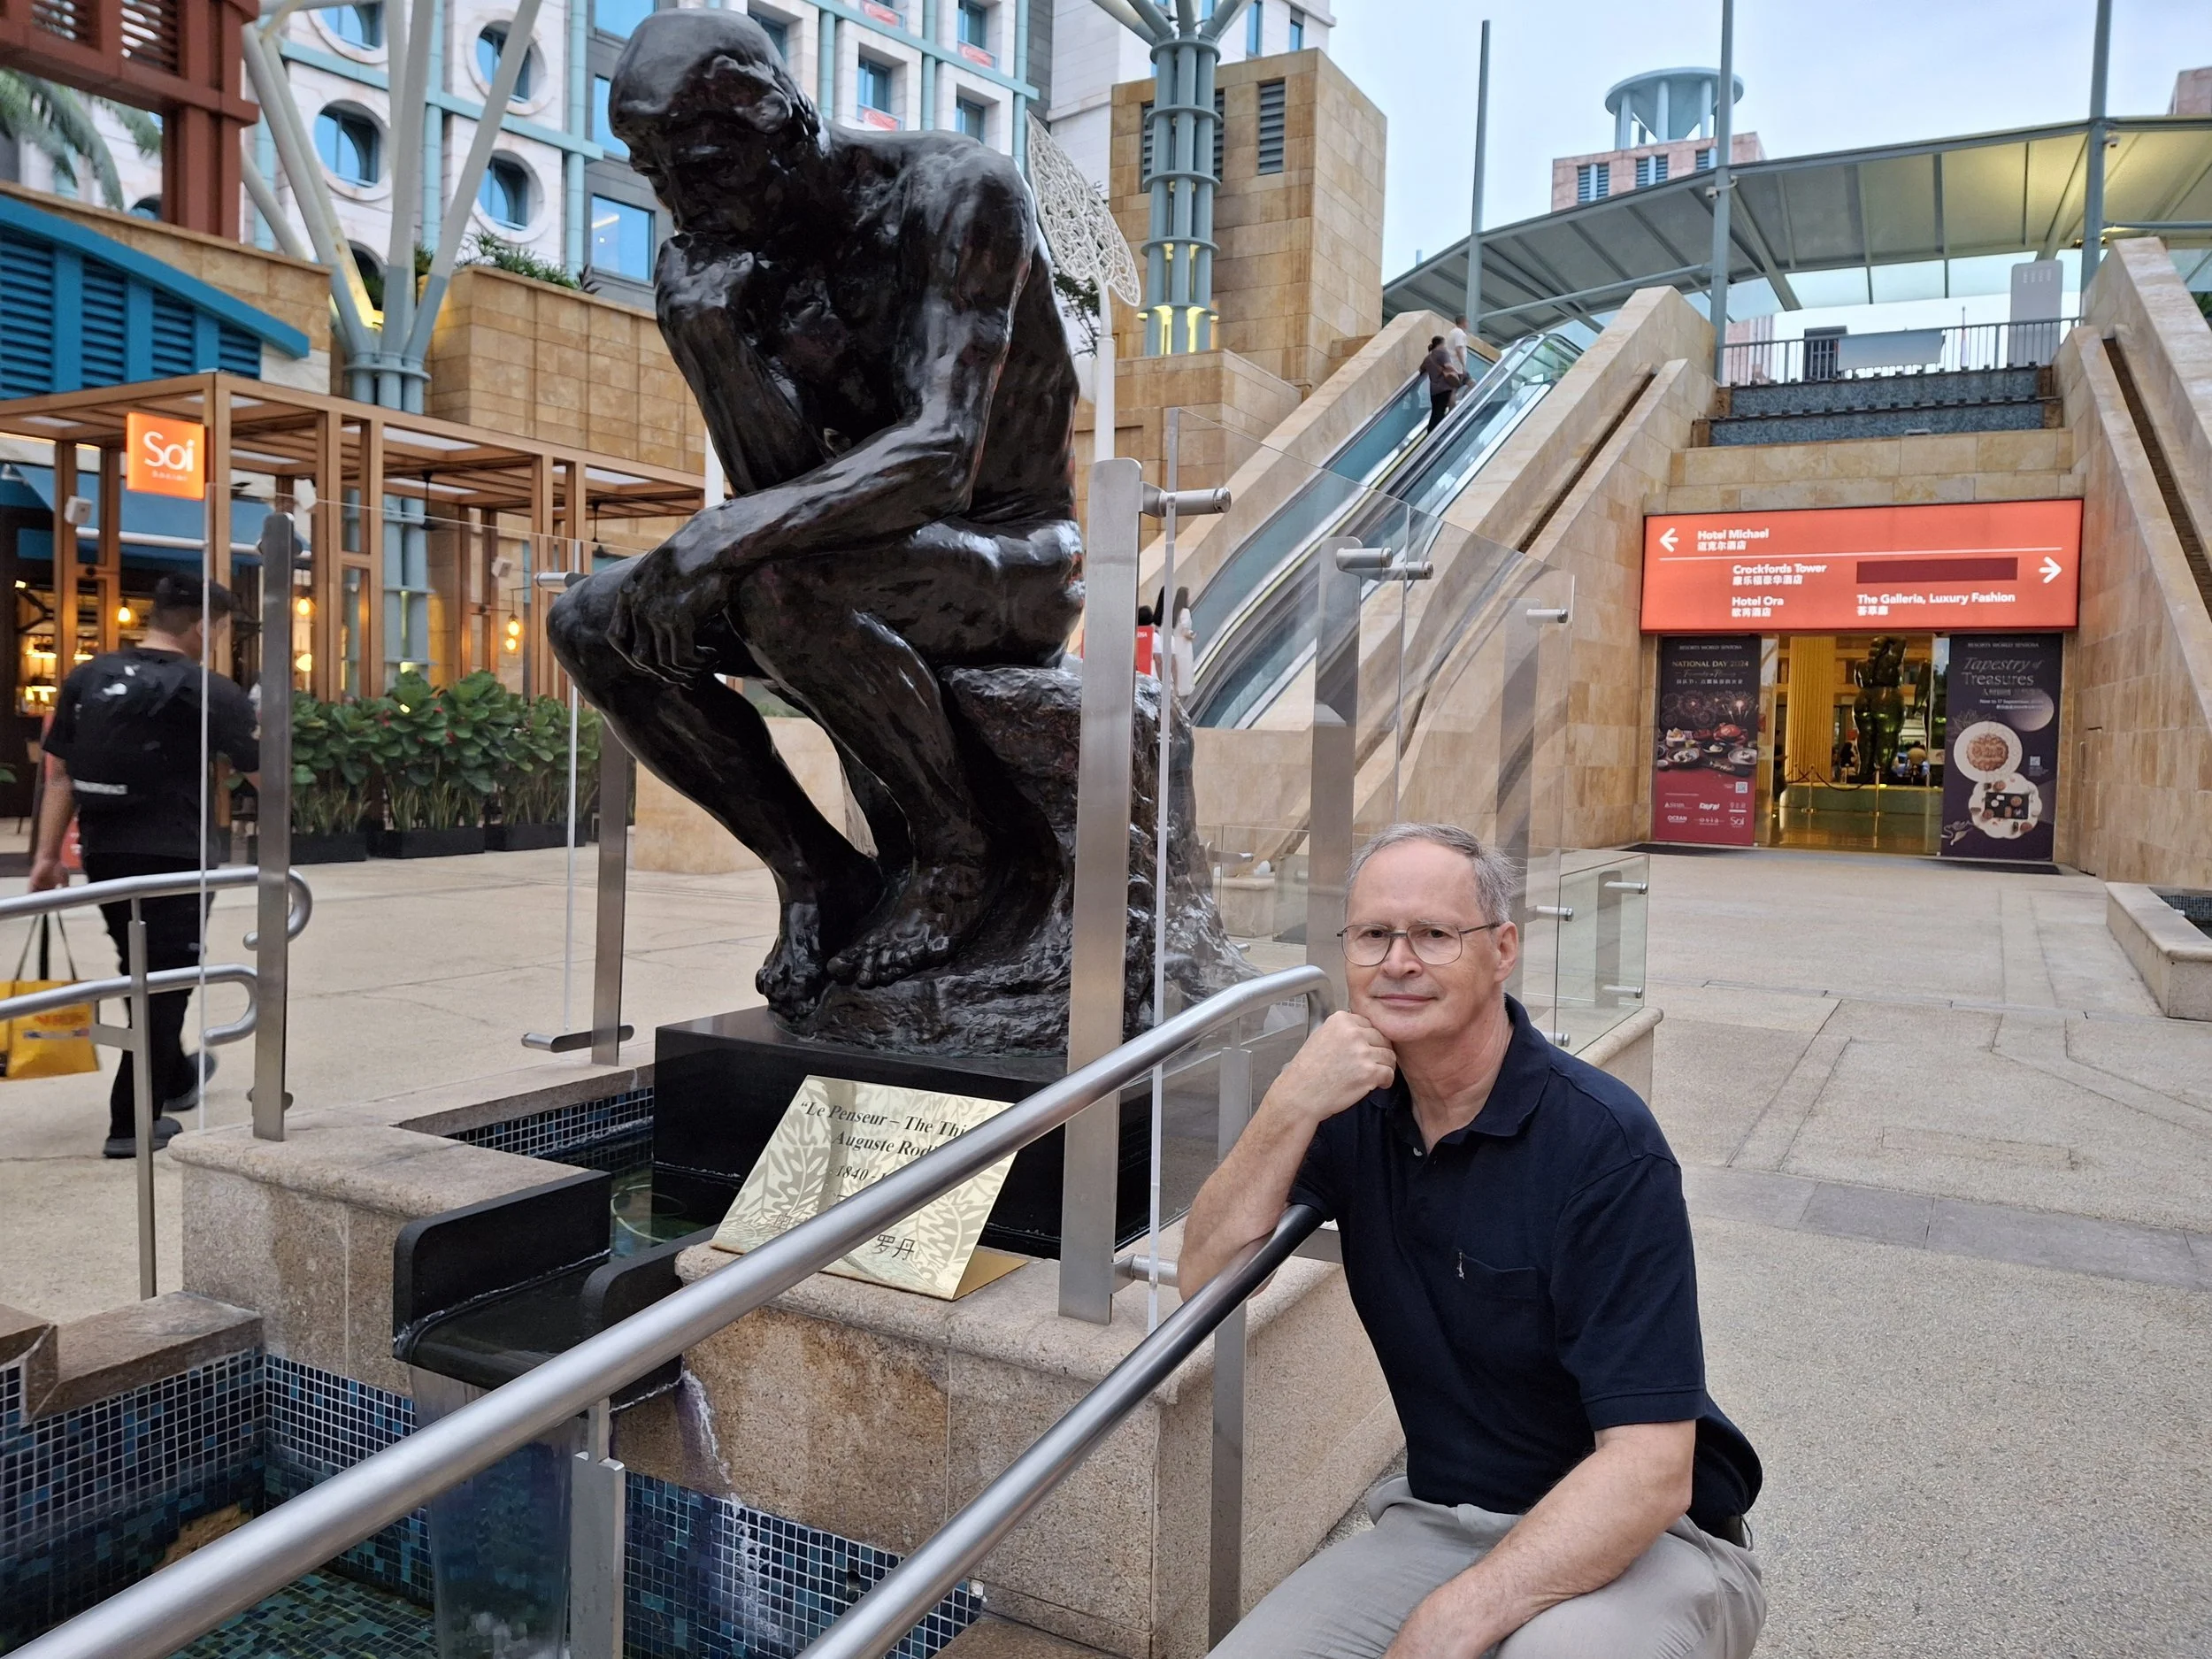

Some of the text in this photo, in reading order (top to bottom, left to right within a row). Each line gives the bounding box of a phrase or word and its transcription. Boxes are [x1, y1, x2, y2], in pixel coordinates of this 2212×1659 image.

[143, 431, 195, 472] Soi
[1698, 528, 1769, 540] Hotel Michael
[1732, 563, 1827, 574] Crockfords Tower
[1732, 596, 1784, 606] Hotel Ora
[1857, 592, 2016, 606] The Galleria, Luxury Fashion
[1963, 657, 2031, 672] Tapestry
[1961, 672, 2034, 686] Treasures
[828, 1105, 887, 1125] Penseur
[903, 1116, 933, 1133] The
[937, 1120, 967, 1138] Thi
[832, 1131, 938, 1156] Auguste Rod
[835, 1165, 869, 1181] 1840
[872, 1234, 917, 1261] 罗丹
